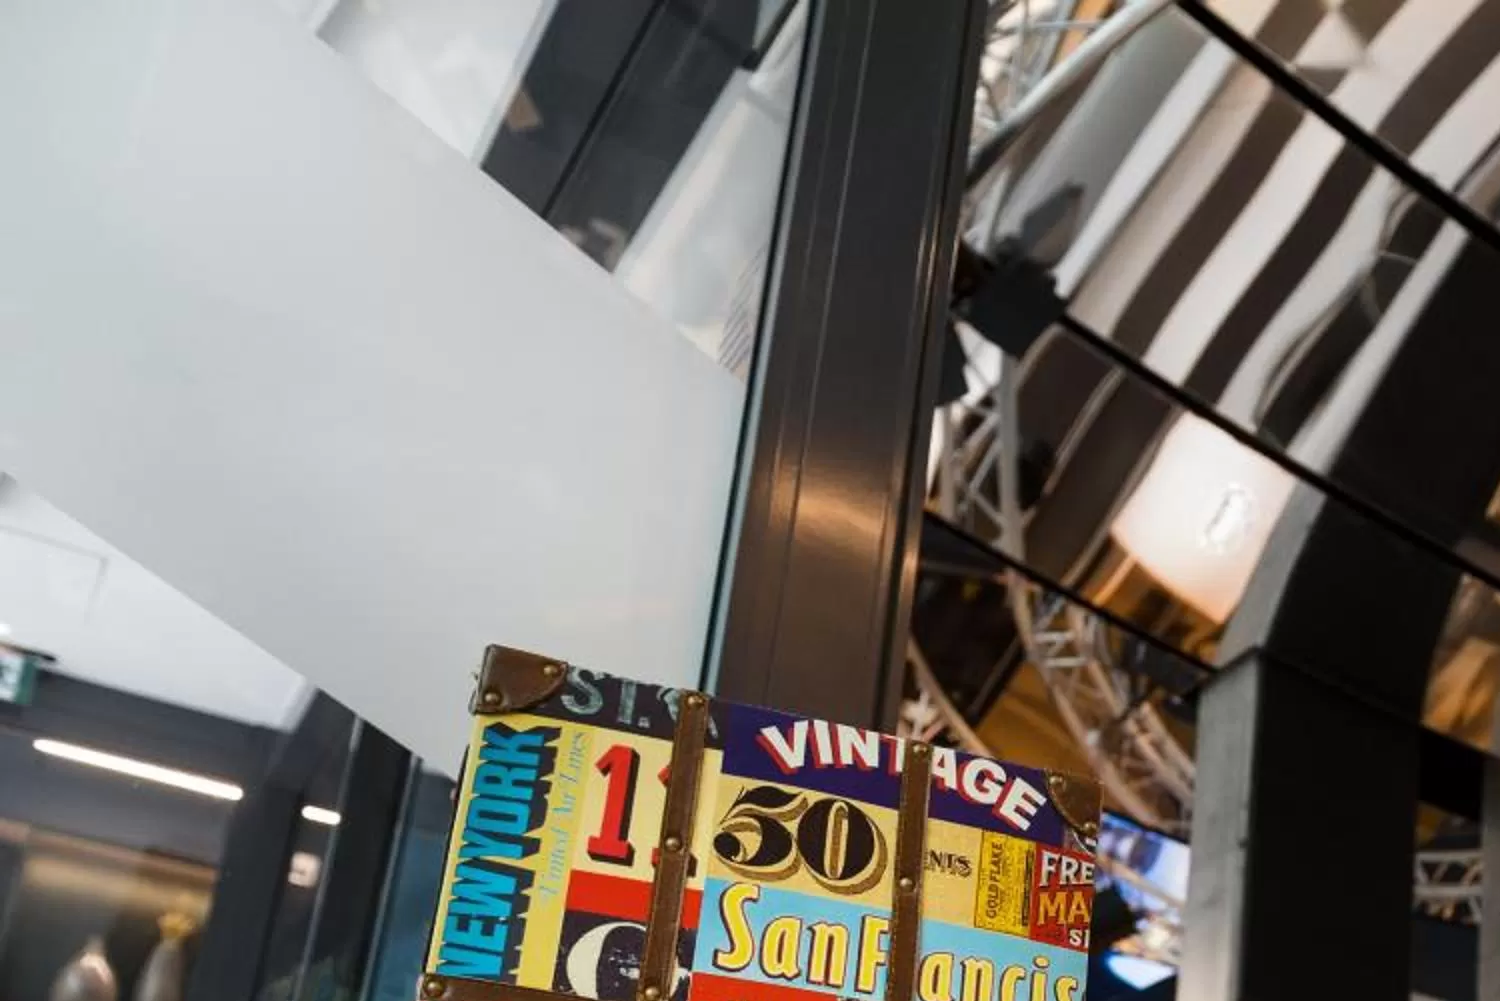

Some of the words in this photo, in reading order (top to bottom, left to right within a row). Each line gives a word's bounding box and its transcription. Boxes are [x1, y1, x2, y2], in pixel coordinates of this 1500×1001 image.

[713, 785, 888, 894] 50
[925, 850, 972, 877] NTS
[989, 841, 1004, 882] FLAKE
[986, 884, 1000, 918] GOLD
[1037, 890, 1093, 926] MA
